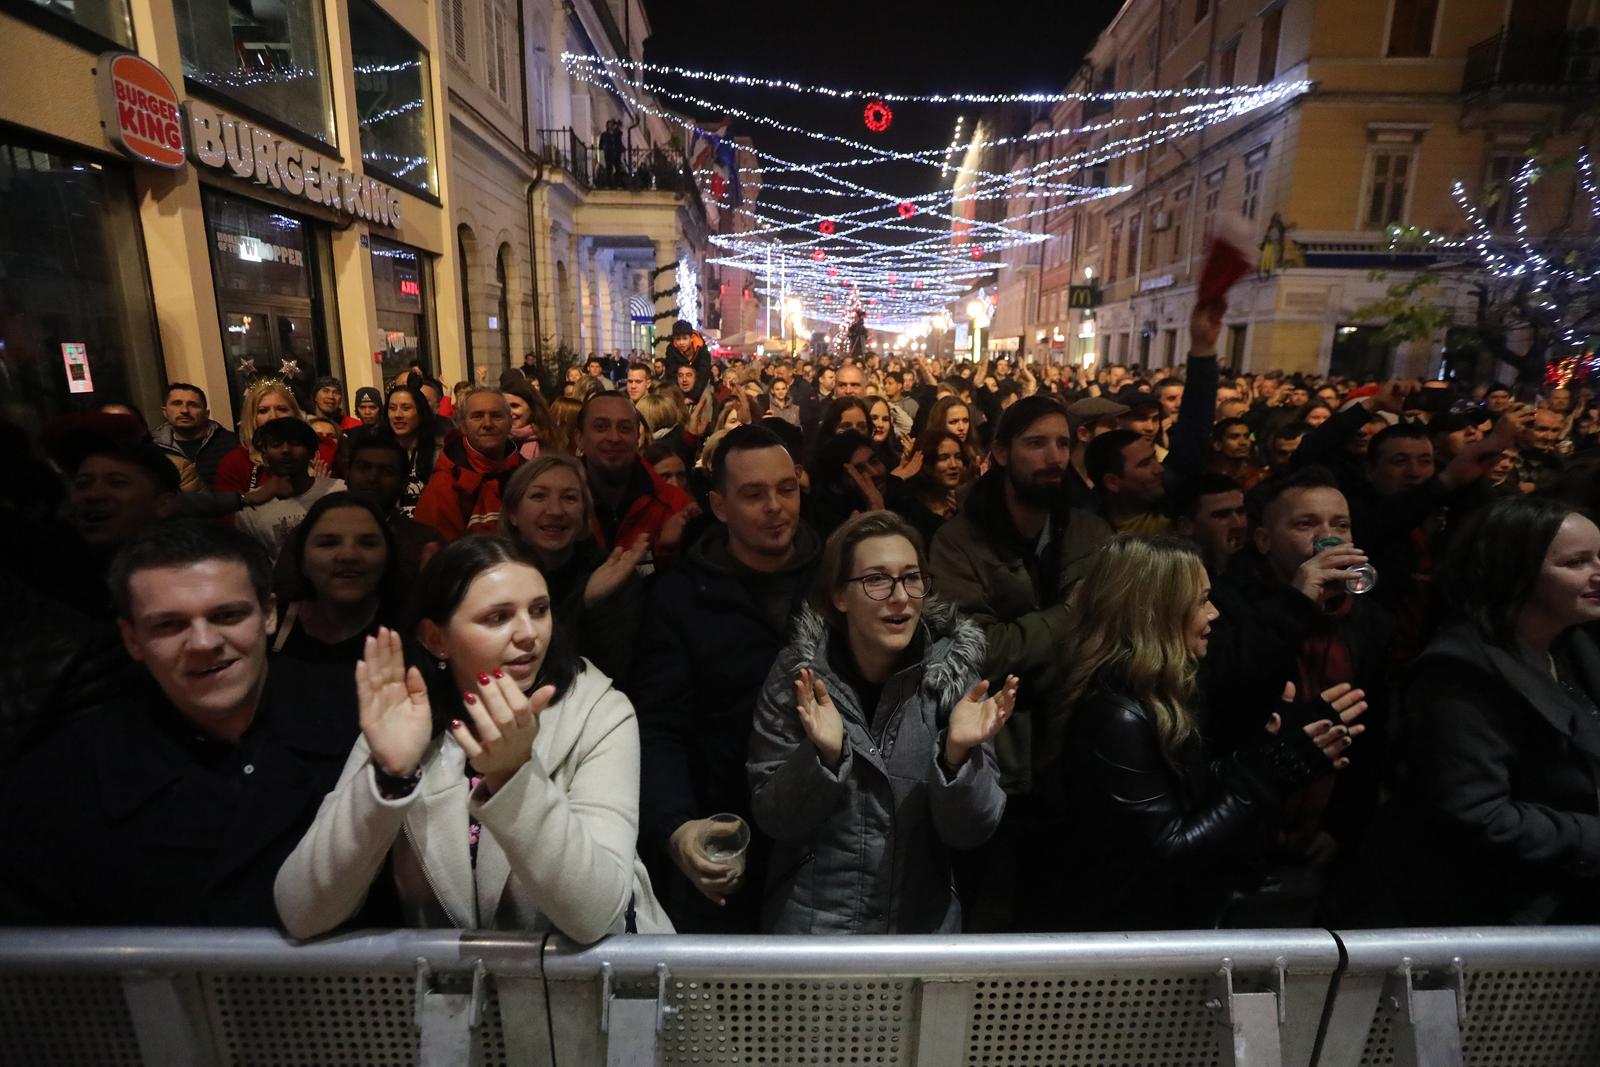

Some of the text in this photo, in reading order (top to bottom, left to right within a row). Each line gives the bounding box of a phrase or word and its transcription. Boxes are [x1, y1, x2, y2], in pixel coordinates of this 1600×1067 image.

[114, 79, 179, 123] BURGER
[118, 102, 182, 150] KING
[190, 100, 401, 230] BURGER KING
